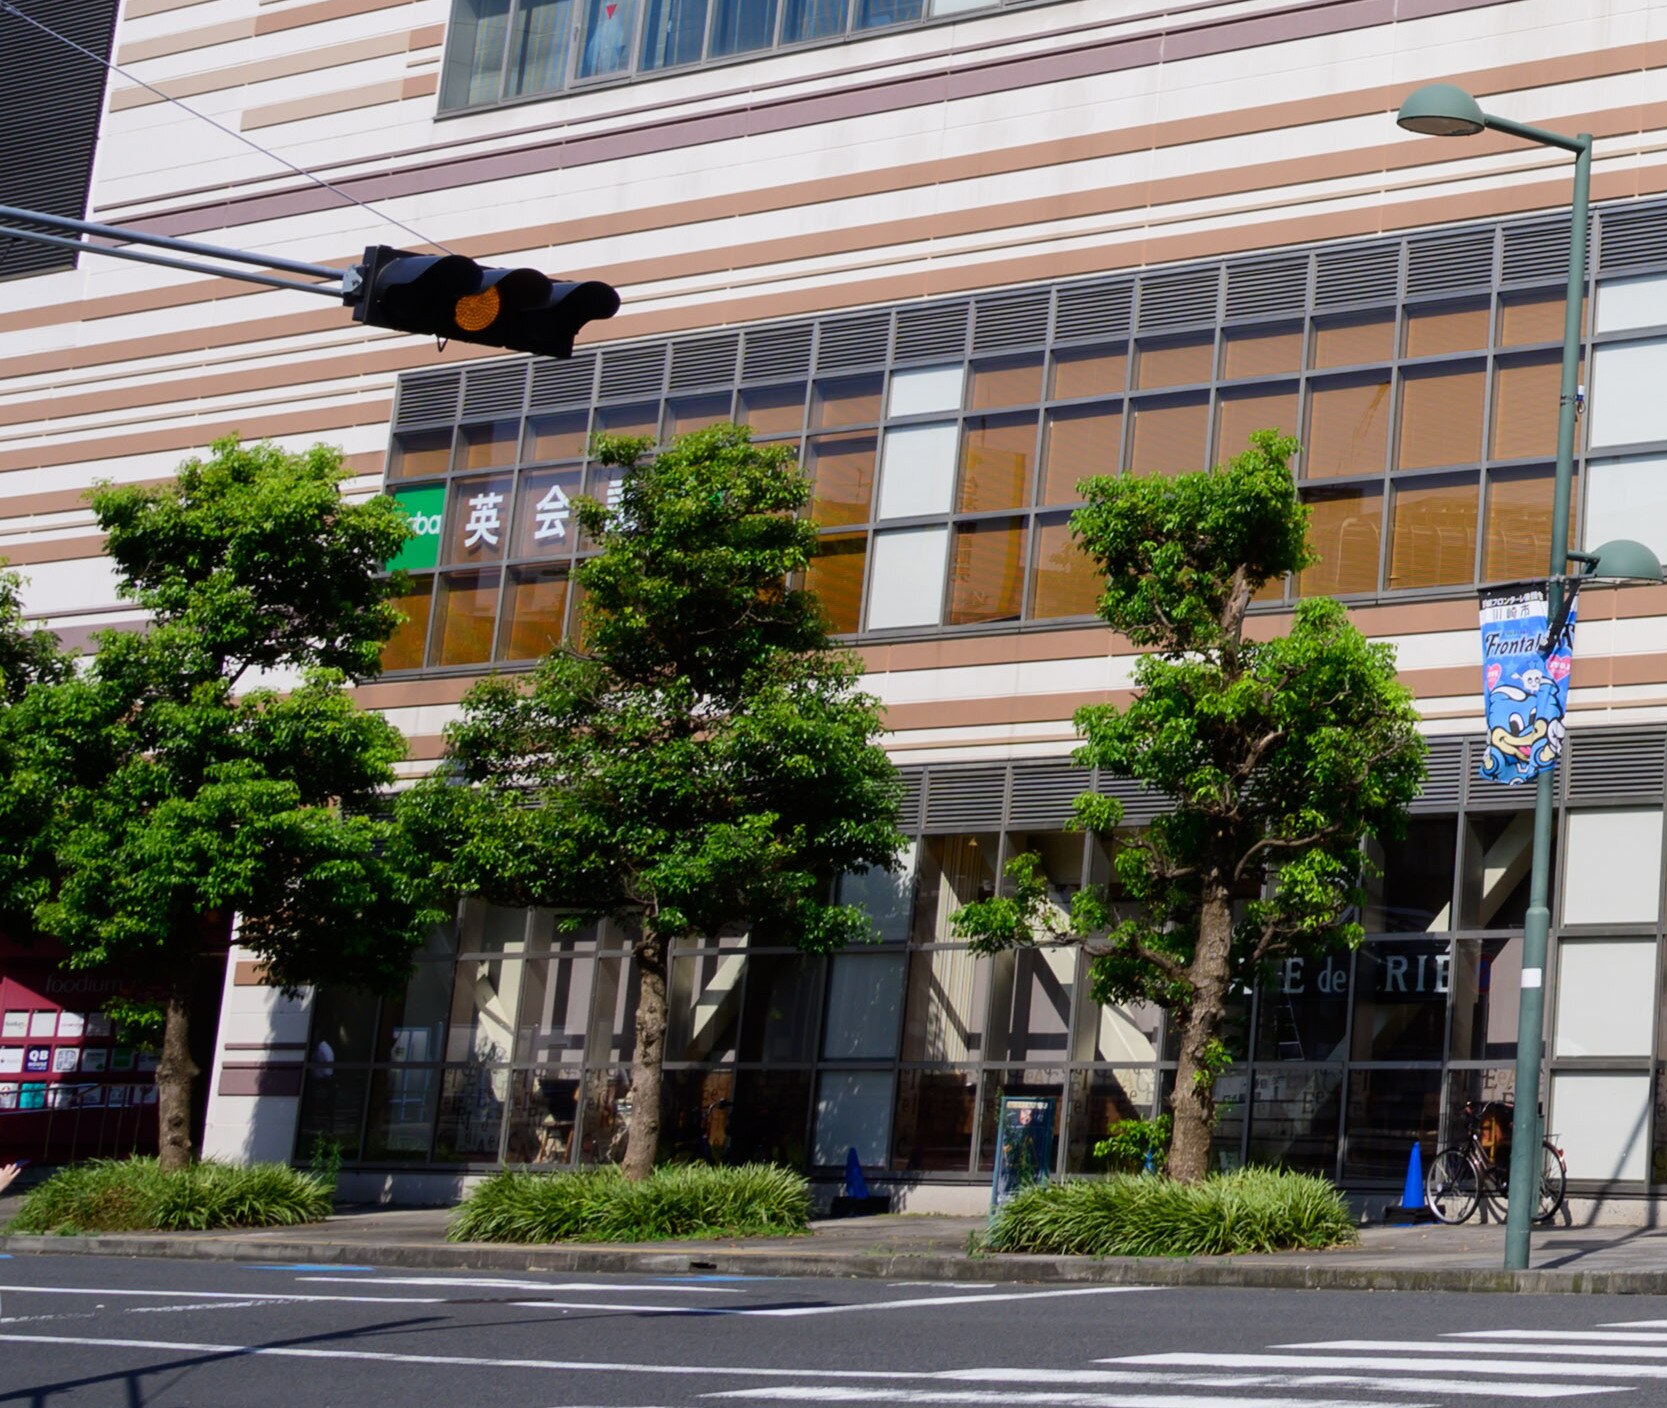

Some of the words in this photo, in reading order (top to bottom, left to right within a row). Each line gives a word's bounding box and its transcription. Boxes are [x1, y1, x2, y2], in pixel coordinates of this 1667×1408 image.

[1485, 633, 1542, 657] Frontal
[1317, 956, 1347, 993] de
[29, 1049, 48, 1061] QB
